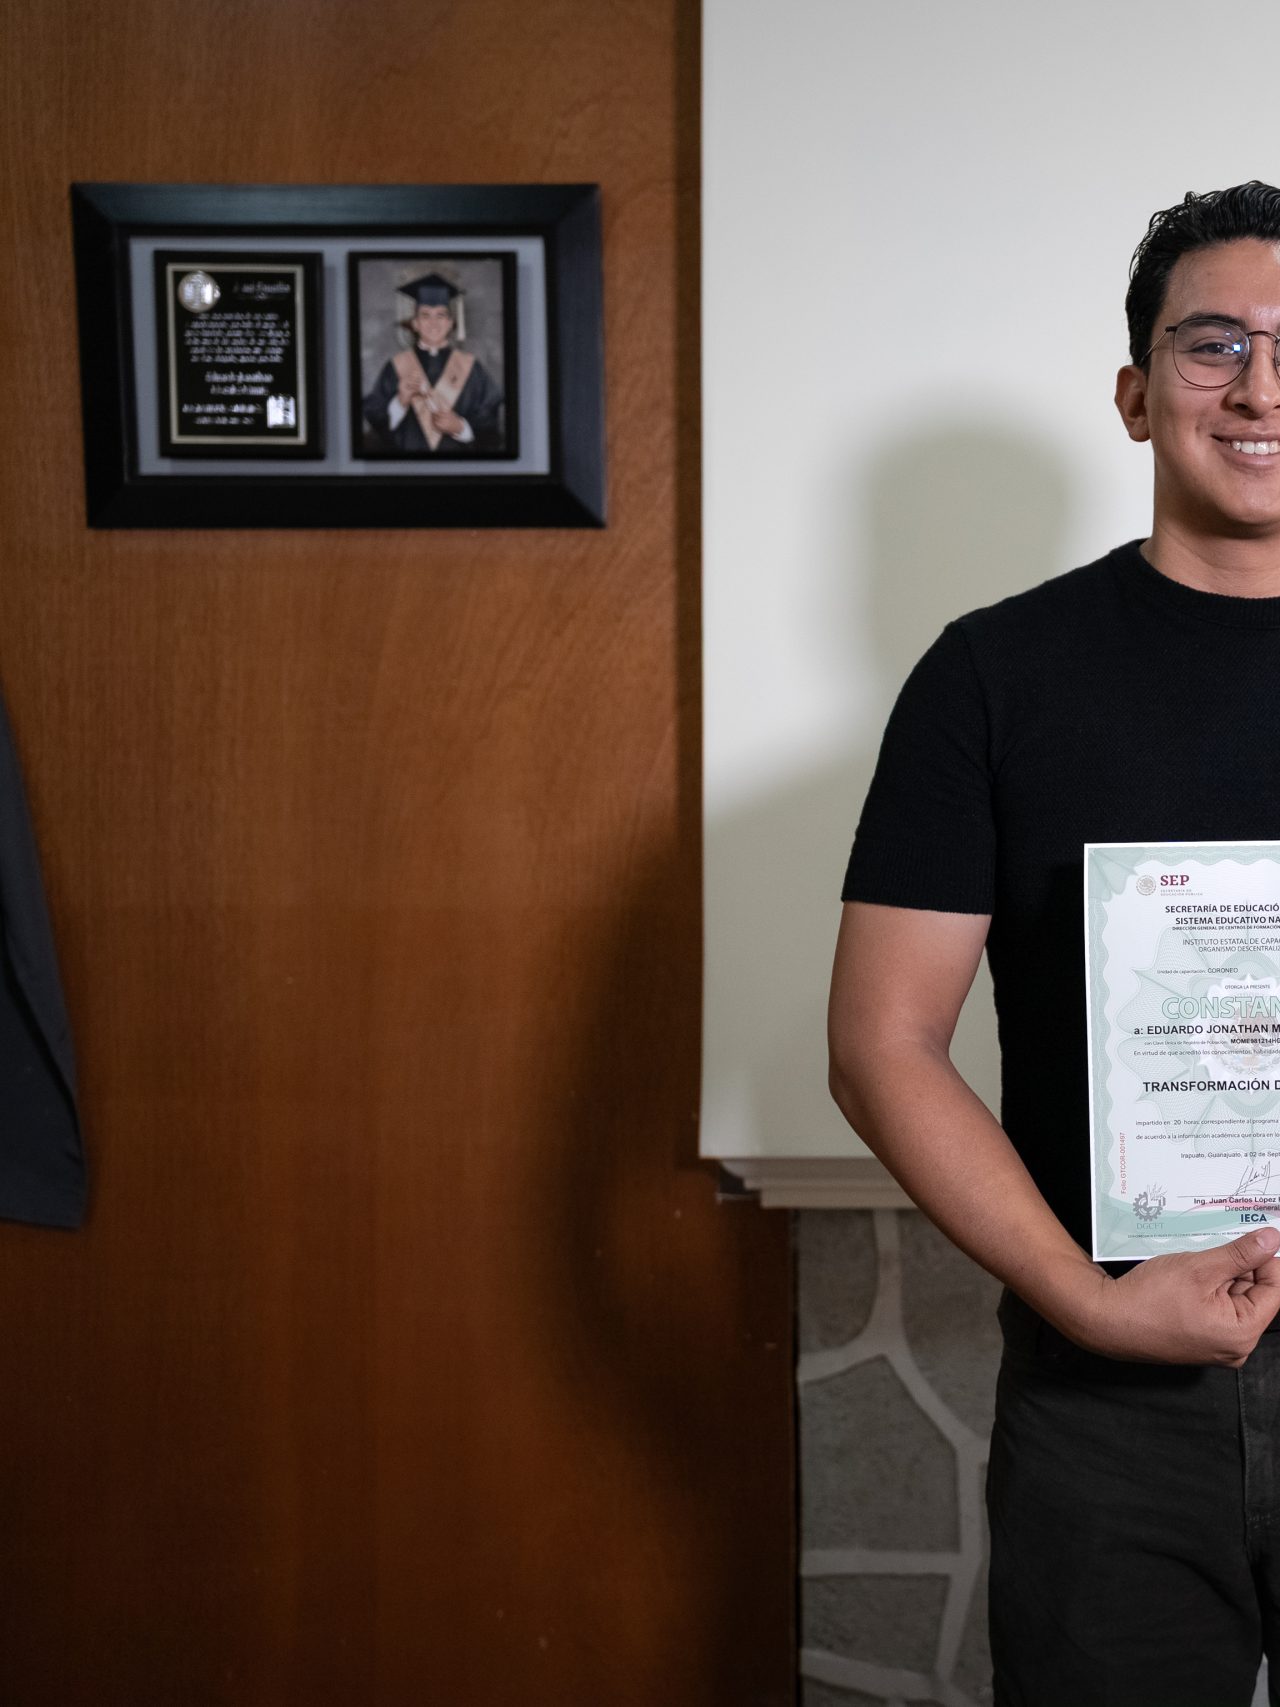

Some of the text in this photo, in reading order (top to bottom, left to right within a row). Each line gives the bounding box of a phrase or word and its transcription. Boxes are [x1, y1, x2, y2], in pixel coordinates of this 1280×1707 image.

[1160, 874, 1190, 886] SEP
[1165, 904, 1218, 913] SECRETARÍA
[1219, 905, 1232, 913] DE
[1175, 917, 1214, 925] SISTEMA
[1215, 916, 1267, 924] EDUCATIVO
[1133, 1027, 1143, 1035] a:
[1147, 1025, 1204, 1035] EDUARDO
[1206, 1024, 1269, 1034] JONATHAN
[1142, 1078, 1270, 1092] TRANSFORMACIÓN
[1254, 1195, 1276, 1204] López
[1240, 1213, 1268, 1222] IECA
